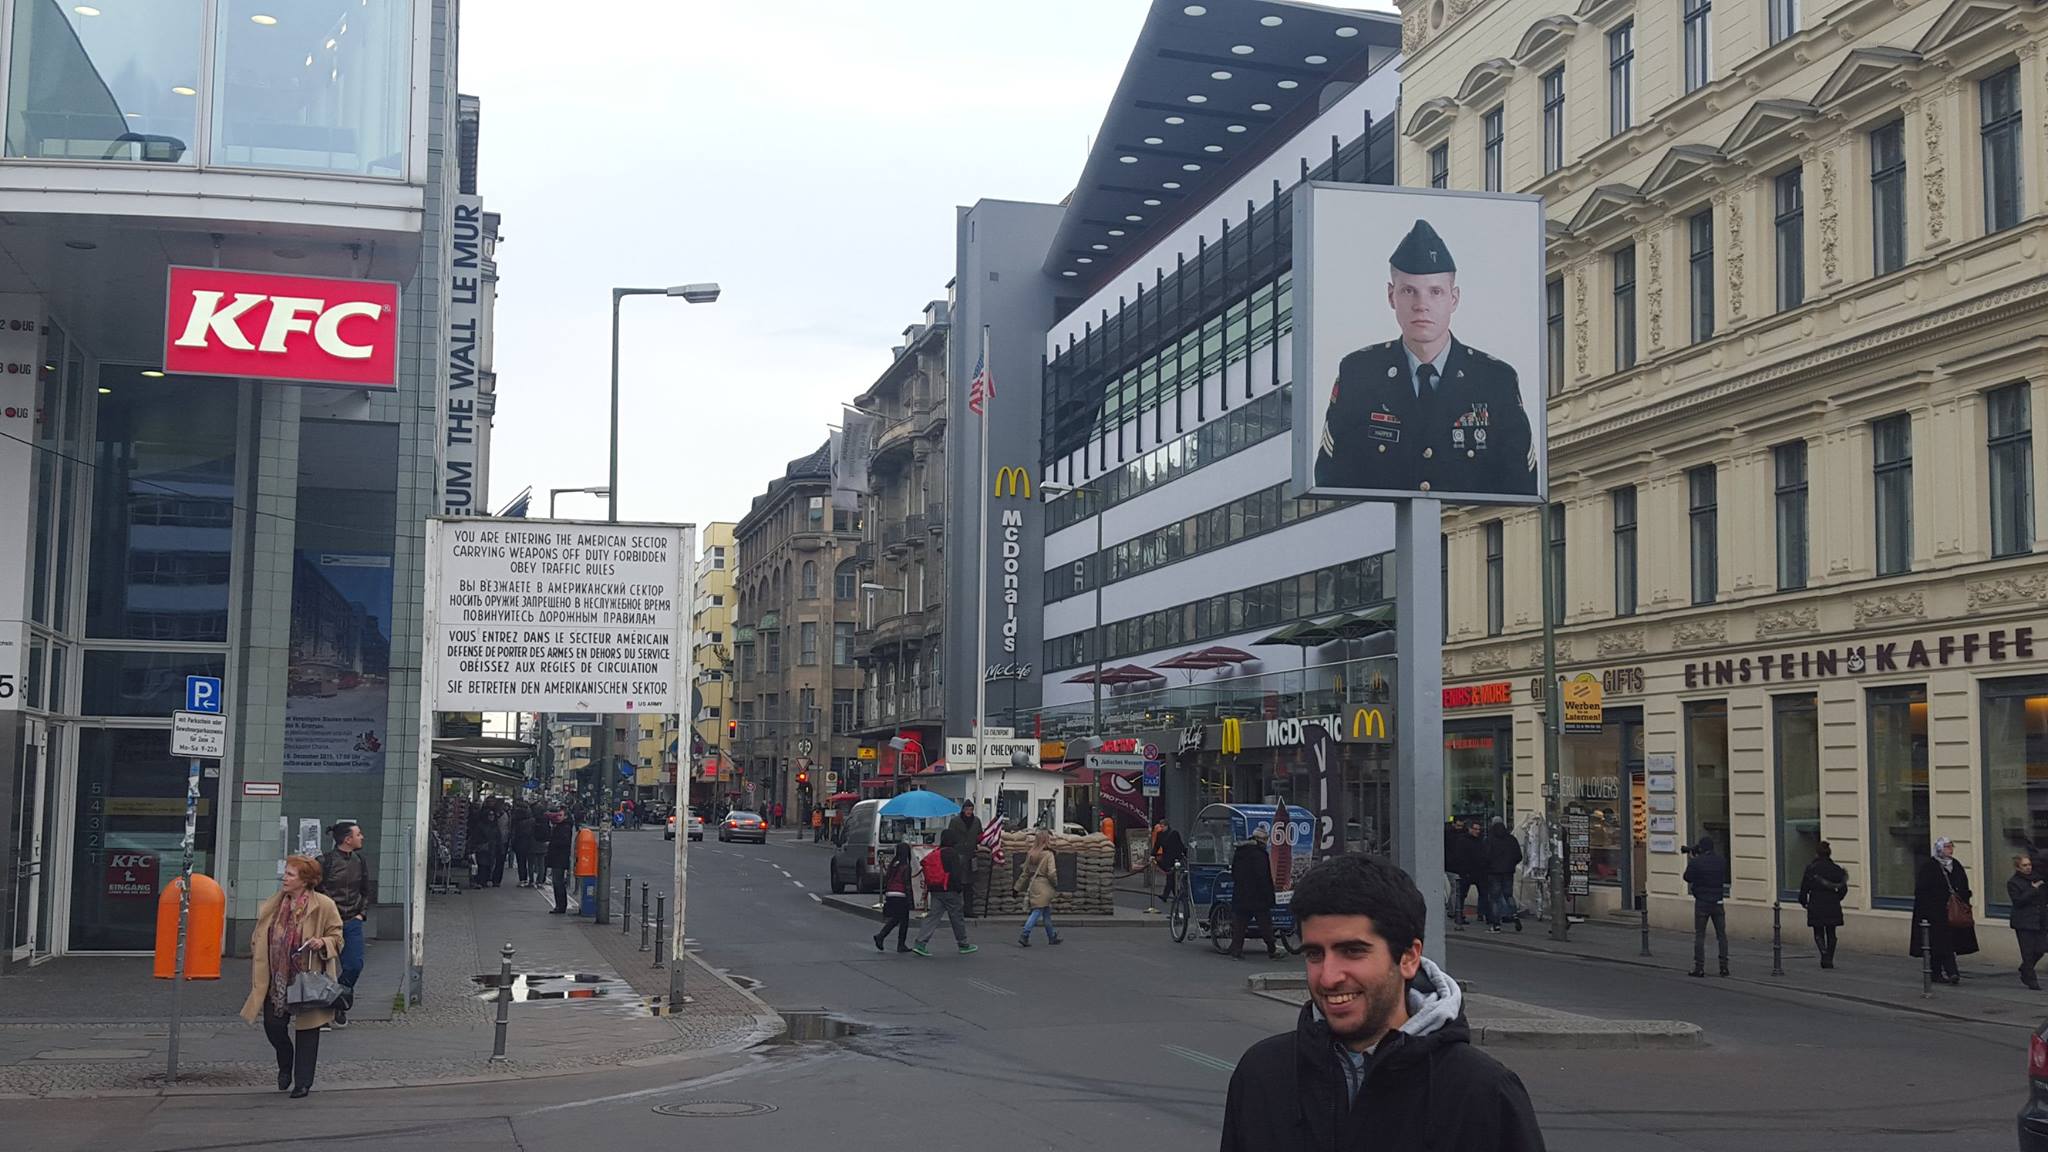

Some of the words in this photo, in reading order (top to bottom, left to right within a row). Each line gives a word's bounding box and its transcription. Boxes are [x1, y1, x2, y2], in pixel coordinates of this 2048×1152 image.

[454, 204, 480, 268] MUR
[453, 276, 477, 304] LE
[174, 289, 382, 359] KFC
[450, 318, 476, 390] WALL
[447, 398, 474, 447] THE
[455, 531, 475, 543] YOU
[481, 532, 499, 543] ARE
[505, 533, 551, 545] ENTERING
[557, 534, 571, 545] THE
[577, 534, 626, 547] AMERICAN
[632, 537, 667, 548] SECTOR
[453, 546, 505, 558] CARRYING
[510, 548, 558, 560] WEAPONS
[563, 550, 580, 560] OFF
[586, 550, 609, 561] DUTY
[614, 551, 666, 562] FORBIDDEN
[511, 562, 536, 573] OBEY
[542, 563, 580, 574] TRAFFIC
[586, 564, 614, 575] RULES
[450, 631, 476, 643] VOUS
[483, 632, 518, 643] ENTREZ
[524, 632, 549, 643] DANS
[555, 633, 564, 643] LE
[569, 633, 610, 644] SECTEUR
[485, 647, 496, 657] DE
[498, 647, 527, 658] PORTER
[530, 648, 545, 658] DES
[547, 648, 574, 658] ARMES
[576, 648, 587, 658] EN
[590, 648, 621, 659] DEHORS
[625, 648, 635, 659] DU
[637, 648, 670, 660] SERVICE
[1684, 649, 1837, 688] EINSTEIN
[1876, 627, 2034, 671] KAFFEE
[516, 662, 535, 672] AUX
[581, 663, 592, 672] DE
[598, 663, 658, 673] CIRCULATION
[448, 680, 463, 693] SIE
[469, 681, 516, 694] BETRETEN
[522, 682, 540, 694] DEN
[544, 682, 627, 694] AMERIKANISCHEN
[632, 683, 667, 695] SEKTOR
[1603, 667, 1645, 693] GIFTS
[194, 681, 213, 707] P
[1565, 701, 1600, 710] Werben
[951, 744, 963, 755] US
[966, 744, 988, 756] ARY
[1560, 776, 1584, 798] ERLIN
[1586, 776, 1619, 799] LOVERS
[110, 855, 153, 867] KFC
